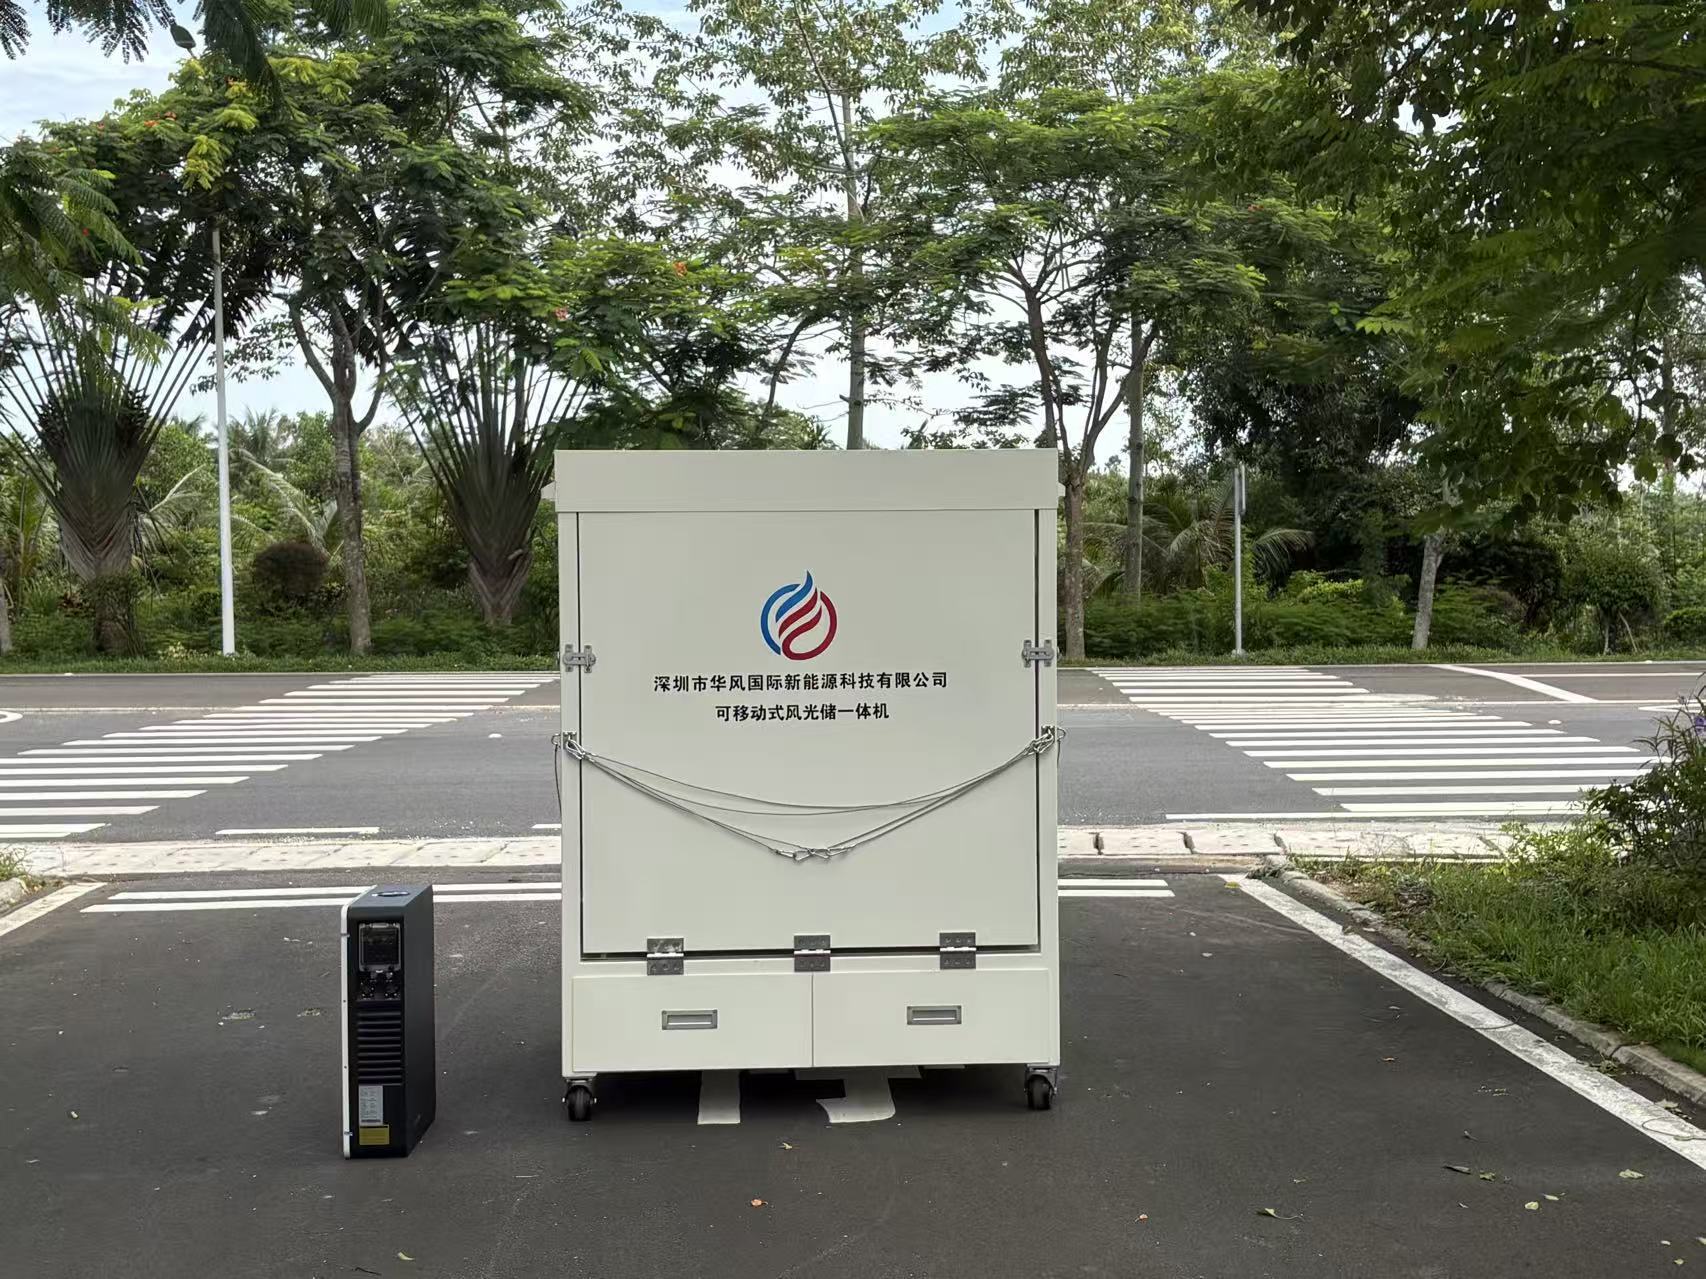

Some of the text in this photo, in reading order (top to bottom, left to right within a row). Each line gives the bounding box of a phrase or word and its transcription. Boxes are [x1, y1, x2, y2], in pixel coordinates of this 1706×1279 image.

[654, 672, 947, 692] 深圳市华风国际新能源科技有限公司
[715, 703, 889, 721] 可移动式风光储一体机
